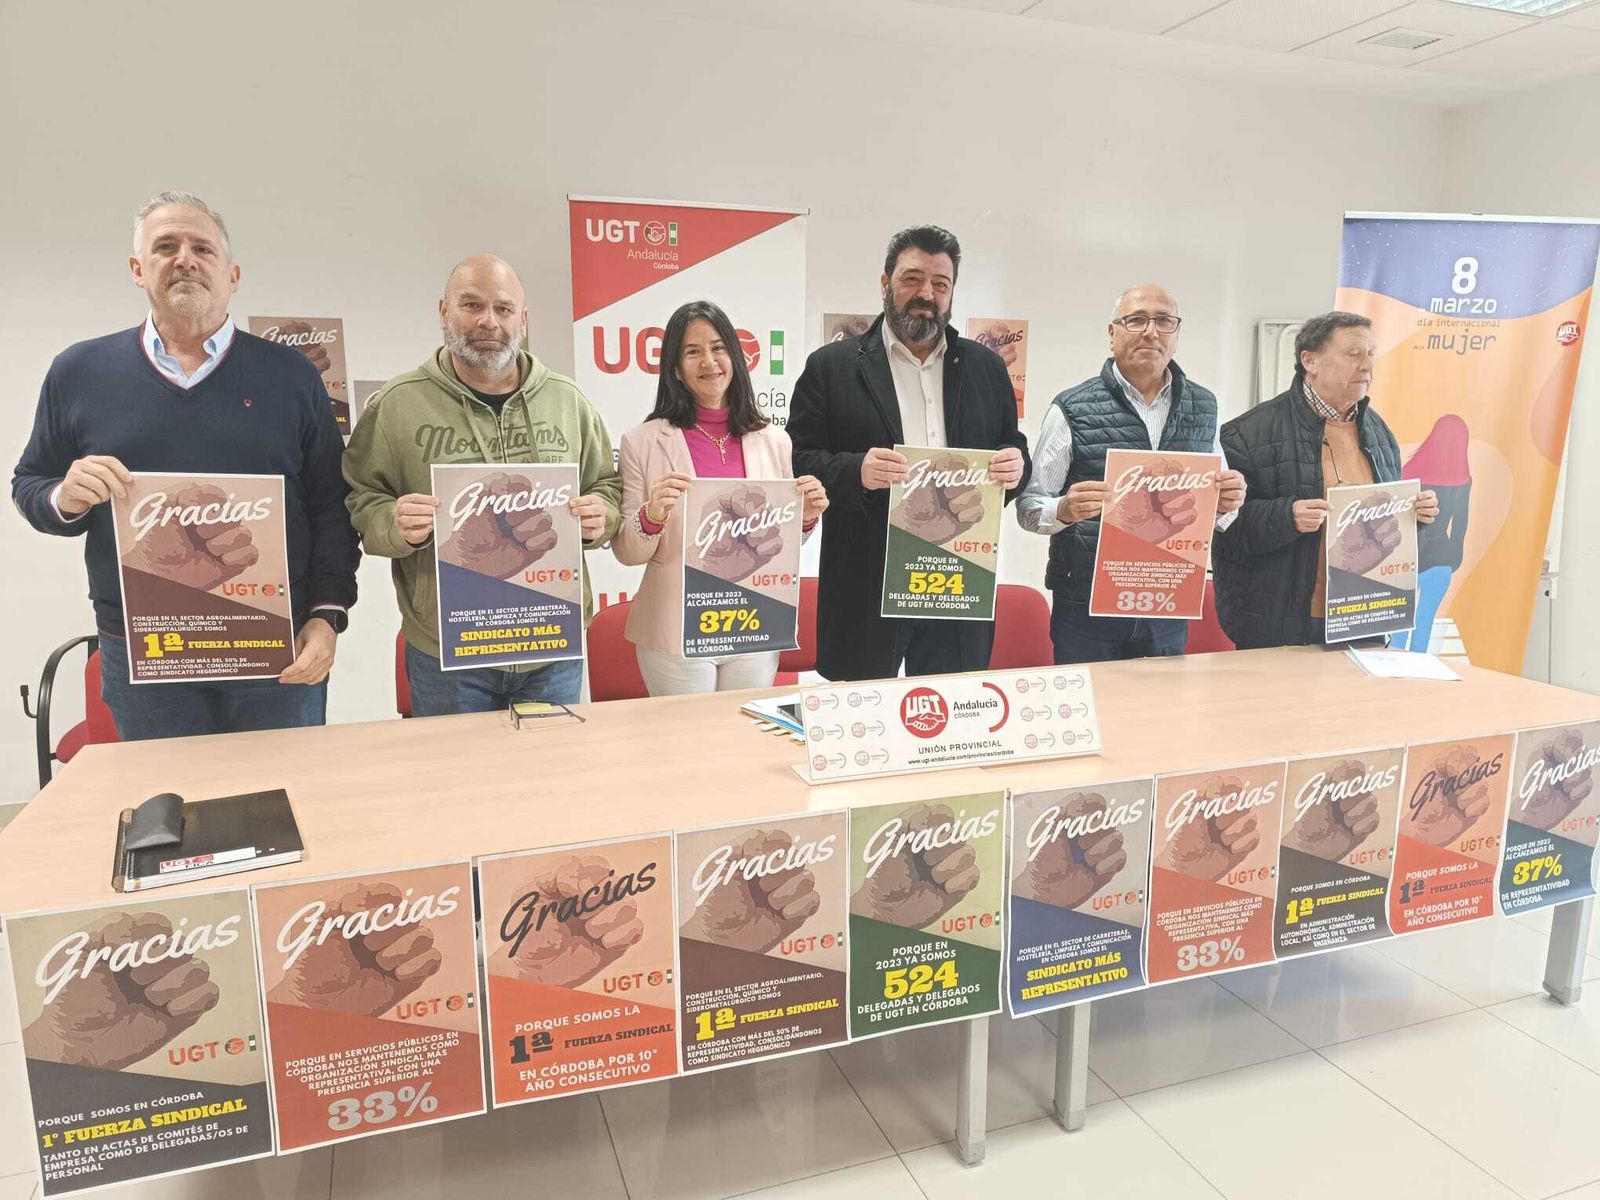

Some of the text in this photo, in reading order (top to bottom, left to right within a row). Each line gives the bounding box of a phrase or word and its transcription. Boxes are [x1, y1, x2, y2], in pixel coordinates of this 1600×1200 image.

[586, 218, 640, 242] UGT
[627, 249, 679, 262] Andalucía
[653, 262, 679, 270] Córdoba
[1451, 256, 1479, 295] 8
[1430, 297, 1497, 314] marzo
[261, 326, 337, 346] Gracias
[1417, 319, 1501, 328] día internacional
[1560, 324, 1578, 336] UGT
[593, 327, 667, 374] UG
[1427, 328, 1497, 355] mujer
[902, 459, 999, 499] Gracia
[1114, 465, 1215, 503] Gracias
[130, 492, 273, 542] Gracias
[451, 481, 572, 532] Gracias
[1337, 495, 1417, 537] Gracias
[695, 501, 796, 558] Gracias
[918, 556, 946, 564] PORQUE
[954, 541, 980, 553] UGT
[222, 583, 258, 596] UGT
[524, 569, 556, 583] UGT
[752, 575, 778, 587] UGT
[908, 572, 965, 595] 524
[687, 598, 738, 606] ALCANZAMOS
[889, 592, 930, 601] DELEGADAS
[936, 601, 970, 609] CÓRDOBA
[1117, 591, 1176, 612] 33%
[1337, 597, 1407, 615] FUERZA SINDICAL
[460, 624, 561, 642] SINDICATO MÁS
[700, 609, 760, 634] 37%
[144, 633, 286, 658] 1ª FUERZA SINDICAL
[455, 638, 568, 657] REPRESENTATIVO
[697, 635, 769, 645] REPRESENTATIVIDAD
[698, 644, 734, 653] CÓRDOBA
[906, 695, 941, 714] UGT
[919, 740, 1002, 754] UNIÓN PROVINCIAL
[1295, 764, 1398, 822] Gracias
[1410, 753, 1503, 821] Gracias
[1165, 780, 1278, 843] Gracias
[863, 808, 999, 879] Gracias
[1026, 799, 1145, 862] Gracias
[692, 834, 837, 907] Gracias
[1512, 854, 1563, 886] 37%
[500, 863, 657, 958] Gracias
[1285, 887, 1385, 925] 1ª FUERZA SINDICAL
[1407, 906, 1478, 927] AÑO CONSECUTIVO
[276, 886, 460, 970] Gracias
[942, 916, 975, 933] UGT
[35, 915, 242, 1005] Gracias
[780, 936, 817, 956] UGT
[892, 941, 948, 957] PORQUE EN
[1177, 935, 1245, 972] 33%
[875, 950, 956, 971] 2023 YA SOMOS
[1026, 952, 1121, 982] SINDICATO MÁS
[603, 973, 644, 994] UGT
[883, 960, 959, 1000] 524
[1021, 966, 1129, 1000] REPRESENTATIVO
[396, 999, 441, 1020] UGT
[515, 1005, 640, 1034] PORQUE SOMOS LA
[695, 998, 840, 1041] 1ª FUERZA SINDICAL
[168, 1041, 220, 1066] UGT
[286, 1031, 459, 1069] PORQUE EN SERVICIOS PÚBLICOS EN
[286, 1039, 460, 1077] CÓRDOBA NOS MANTENEMOS COMO
[509, 1023, 673, 1065] 1ª FUERZA SINDICAL
[300, 1048, 447, 1083] ORGANIZACIÓN SINDICAL MÁS
[308, 1059, 441, 1090] REPRESENTATIVA, CON UNA
[519, 1069, 537, 1081] EN
[541, 1058, 605, 1077] CÓRDOBA
[609, 1054, 634, 1066] POR
[525, 1063, 651, 1093] AÑO CONSECUTIVO
[317, 1068, 434, 1097] PRESENCIA SUPERIOR AL
[38, 1091, 204, 1128] PORQUE SOMOS EN CÓRDOBA
[327, 1081, 439, 1131] 33%
[64, 1118, 147, 1144] FUERZA
[150, 1098, 248, 1128] SINDICAL
[43, 1122, 220, 1163] TANTO EN ACTAS DE COMITÉS DE
[44, 1125, 249, 1172] EMPRESA COMO DE DELEGADAS/OS DE
[46, 1163, 104, 1181] PERSONAL
